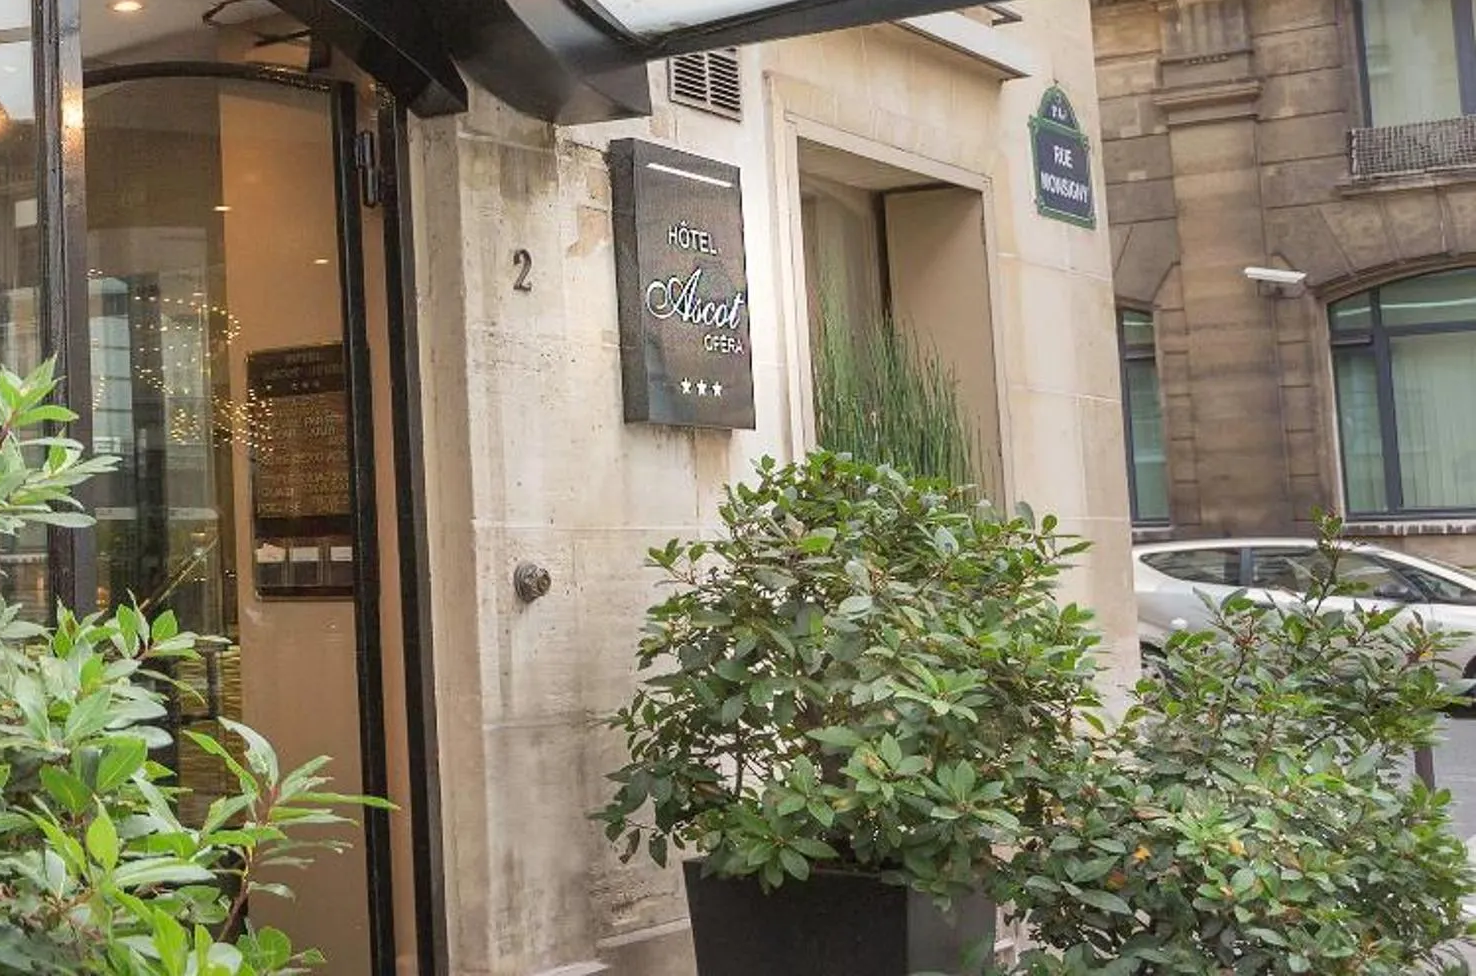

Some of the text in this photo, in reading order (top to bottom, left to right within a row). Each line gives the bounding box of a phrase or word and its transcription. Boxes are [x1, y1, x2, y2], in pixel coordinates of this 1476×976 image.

[668, 221, 718, 255] HÔTEL
[513, 248, 532, 291] 2
[645, 268, 745, 330] Ascot
